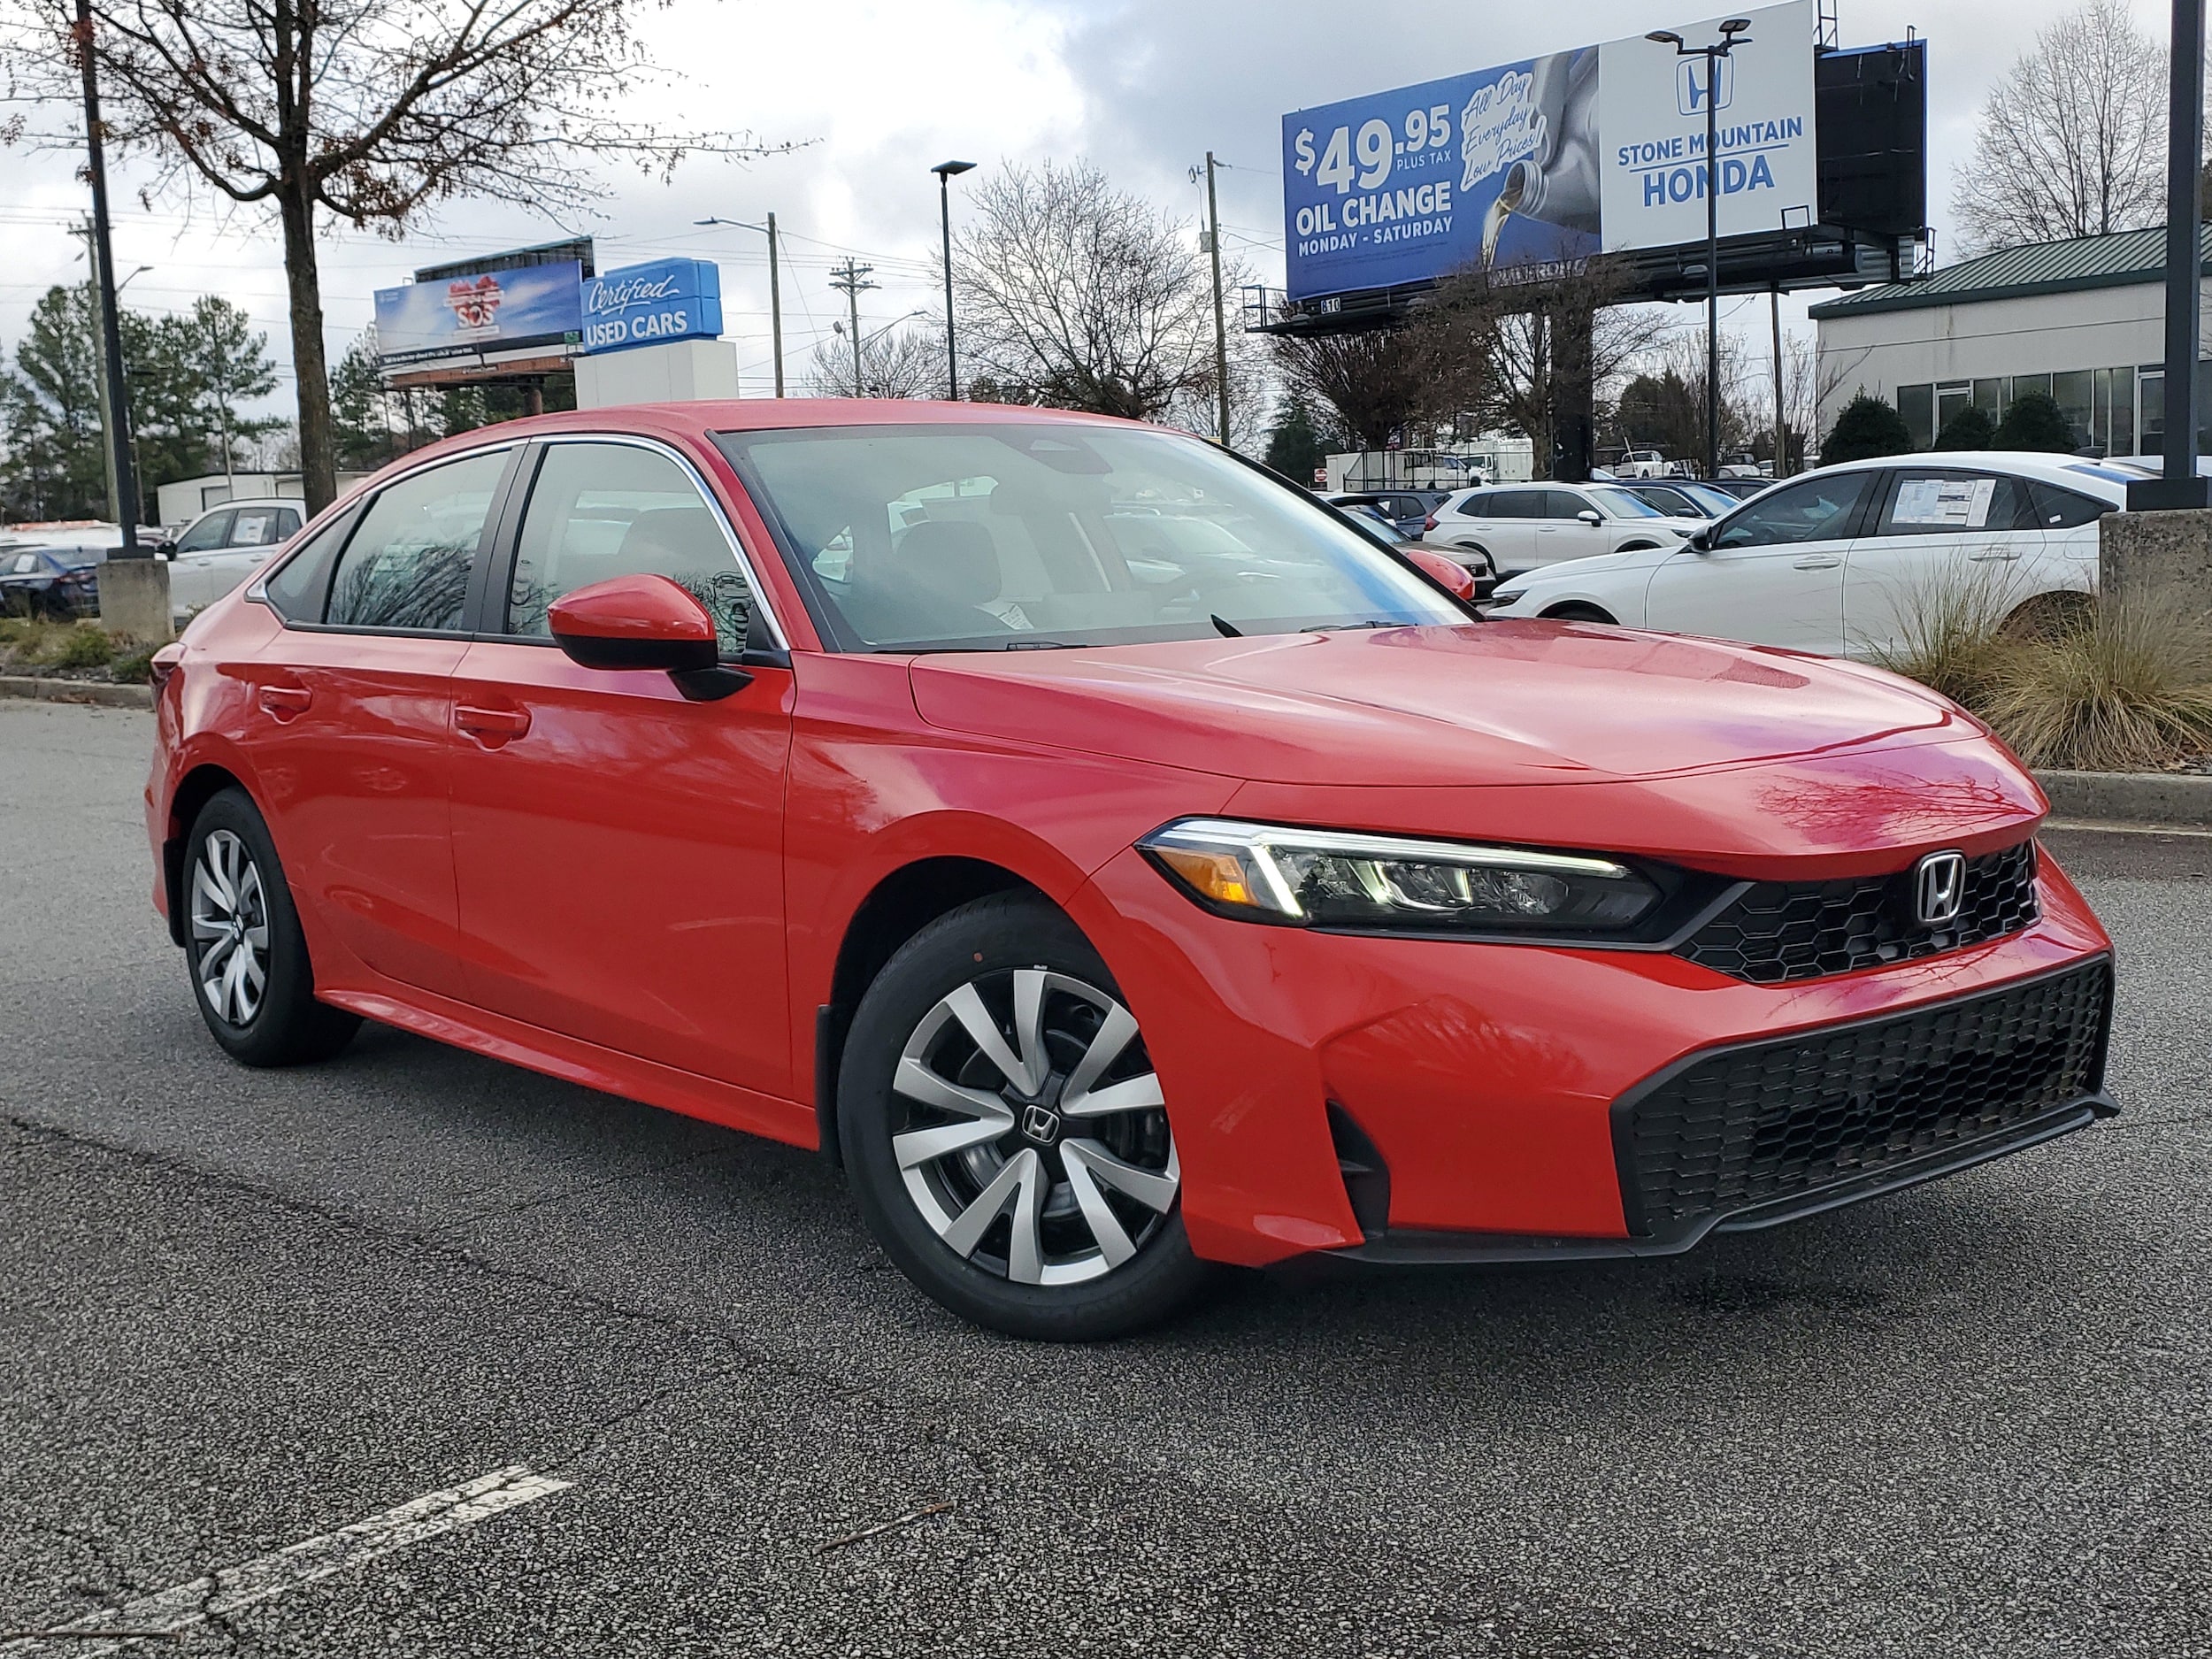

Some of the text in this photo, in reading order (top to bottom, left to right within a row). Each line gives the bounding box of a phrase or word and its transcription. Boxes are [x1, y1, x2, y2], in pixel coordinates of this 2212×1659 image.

[1464, 75, 1529, 126] All Day
[1464, 119, 1543, 186] Low Prices!
[1465, 105, 1529, 156] Everyday
[1618, 116, 1802, 166] STONE MOUNTAIN
[1396, 150, 1451, 171] PLUS TAX
[1644, 154, 1775, 207] HONDA
[1296, 180, 1452, 236] OIL CHANGE
[1298, 232, 1358, 257] MONDAY
[1373, 216, 1453, 244] SATURDAY
[457, 303, 494, 328] SOS
[588, 274, 680, 315] Certified
[587, 311, 687, 347] USED CARS
